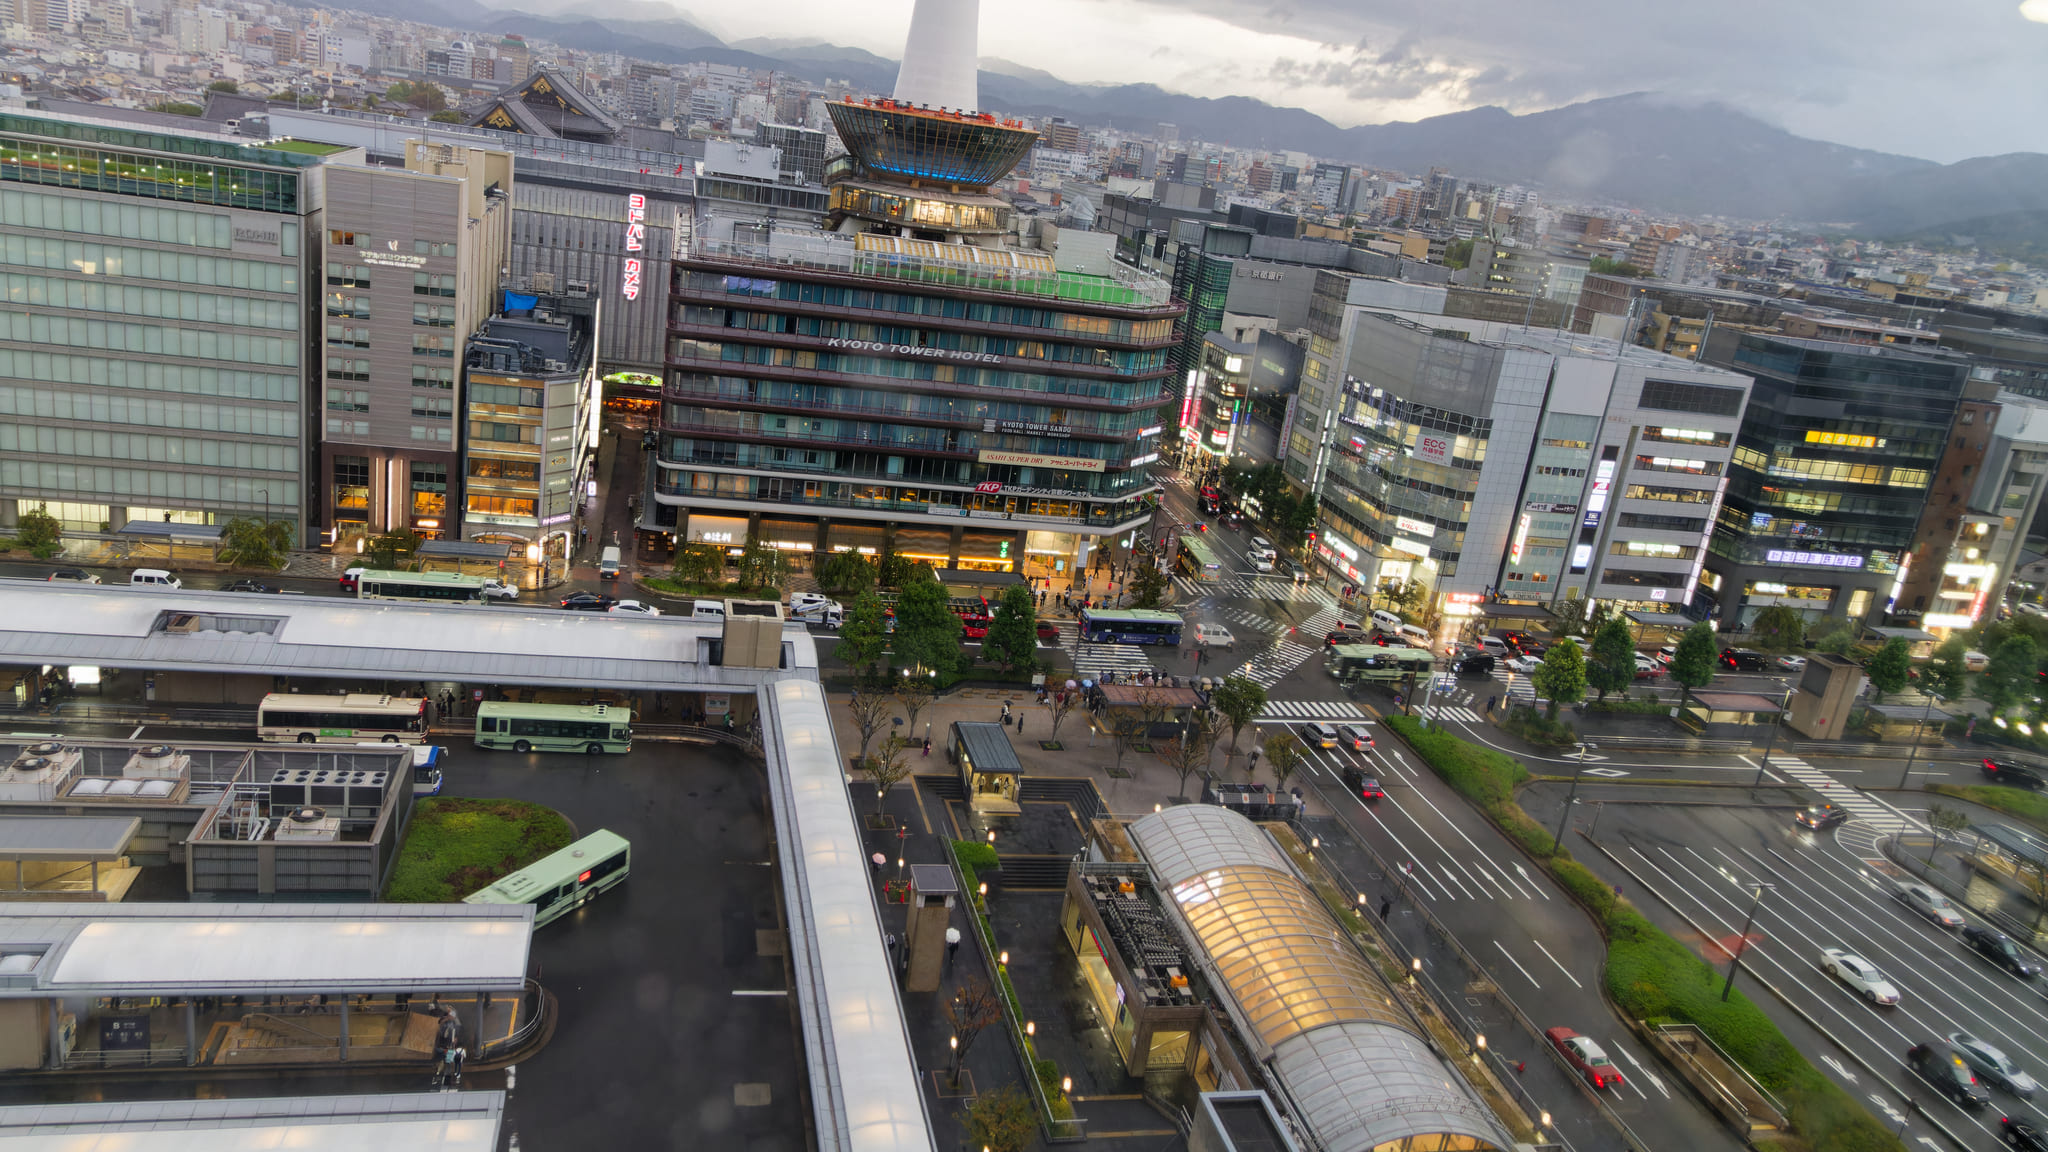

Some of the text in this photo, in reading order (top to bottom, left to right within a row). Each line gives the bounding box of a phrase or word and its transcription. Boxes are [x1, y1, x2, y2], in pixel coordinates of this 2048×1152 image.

[623, 193, 645, 300] ヨドバシ カメラ
[1251, 270, 1285, 281] 京都銀行
[828, 338, 1001, 363] KYOTO TOWER HOTEL
[1002, 421, 1071, 433] KYOTO TOWER SANDO
[1424, 437, 1446, 449] ECC
[987, 453, 1006, 461] ASAHI
[1008, 455, 1029, 463] SUPER
[1050, 459, 1098, 468] アサヒスーパードライ
[976, 483, 1001, 492] TKP
